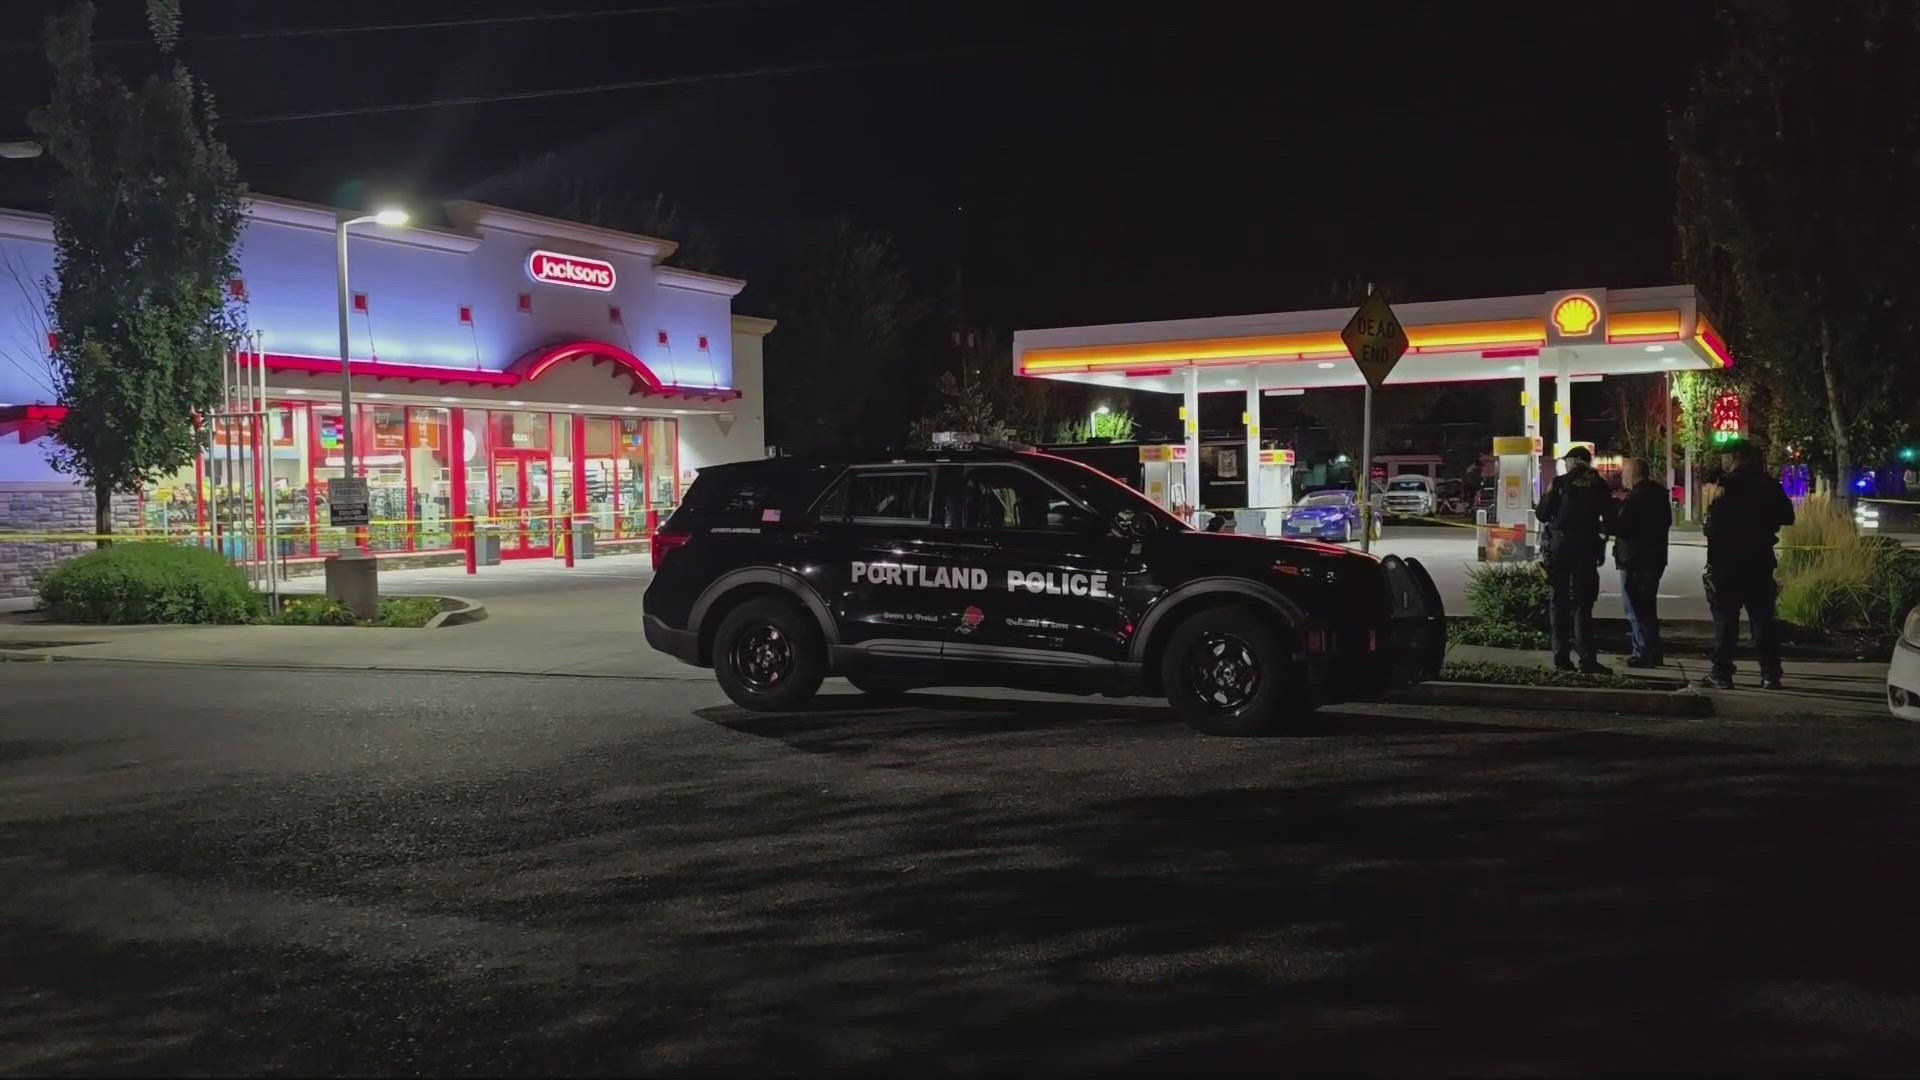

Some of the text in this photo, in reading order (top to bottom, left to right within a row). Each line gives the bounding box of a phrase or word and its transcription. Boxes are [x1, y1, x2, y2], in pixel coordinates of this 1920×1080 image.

[538, 256, 610, 285] Jacksons
[1358, 317, 1396, 338] DEAD
[1362, 344, 1390, 363] END
[851, 561, 1108, 598] PORTLAND POLICE
